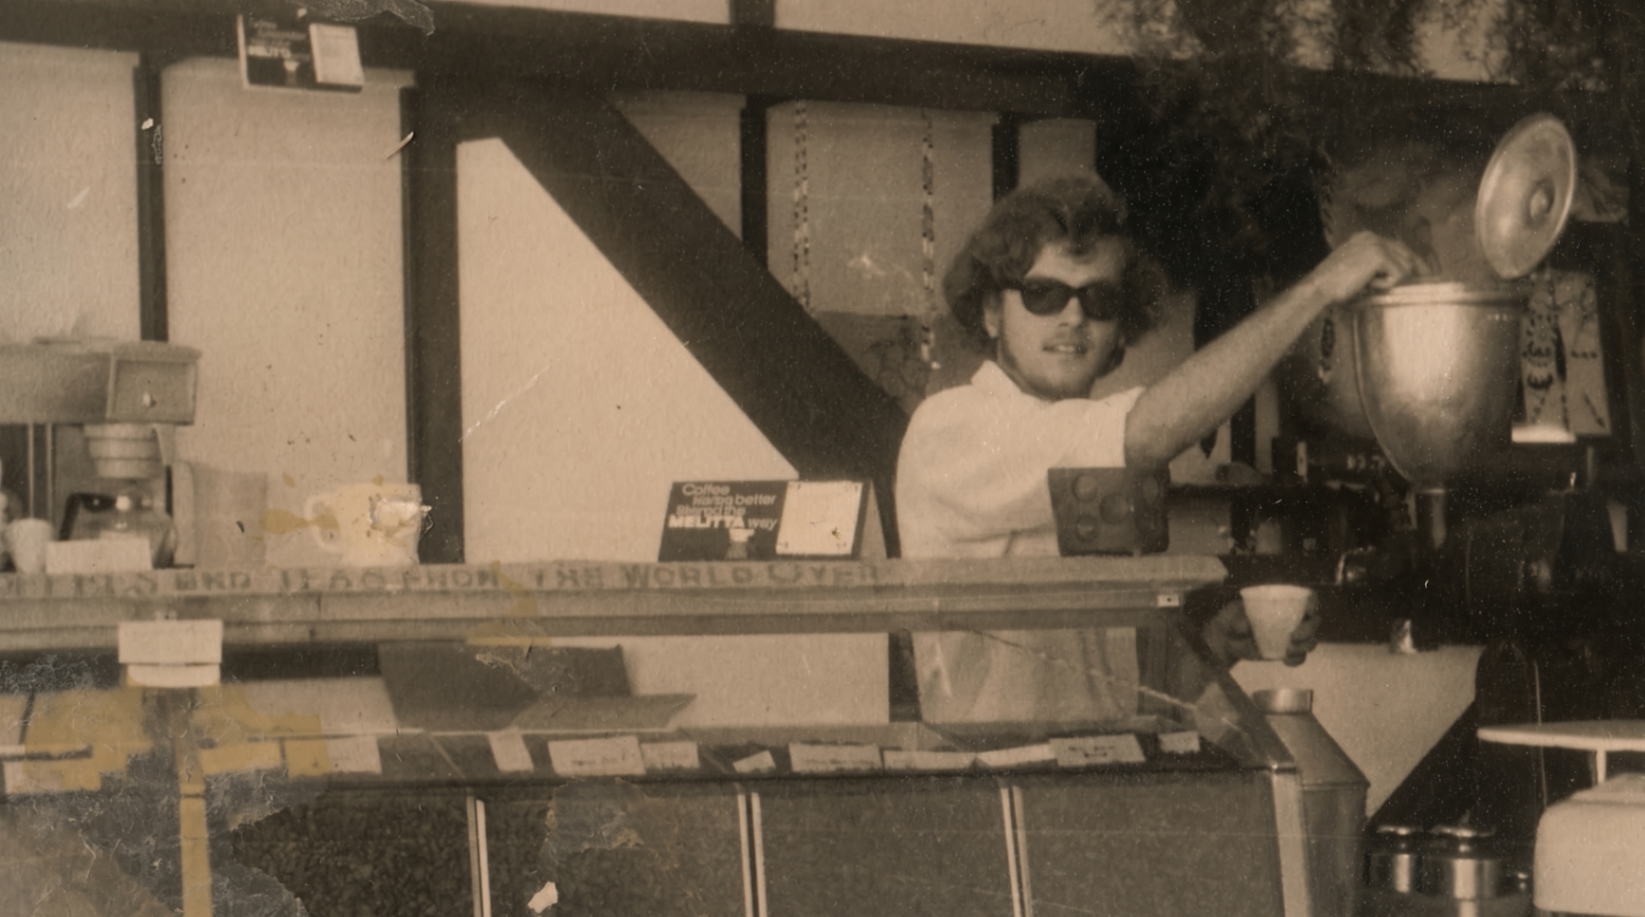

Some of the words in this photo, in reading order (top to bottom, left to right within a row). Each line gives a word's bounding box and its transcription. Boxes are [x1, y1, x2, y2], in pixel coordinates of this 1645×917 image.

[683, 485, 729, 496] Coffee
[736, 494, 777, 505] better
[668, 513, 745, 529] MELITTA
[747, 518, 778, 531] way
[620, 563, 753, 588] WORLD
